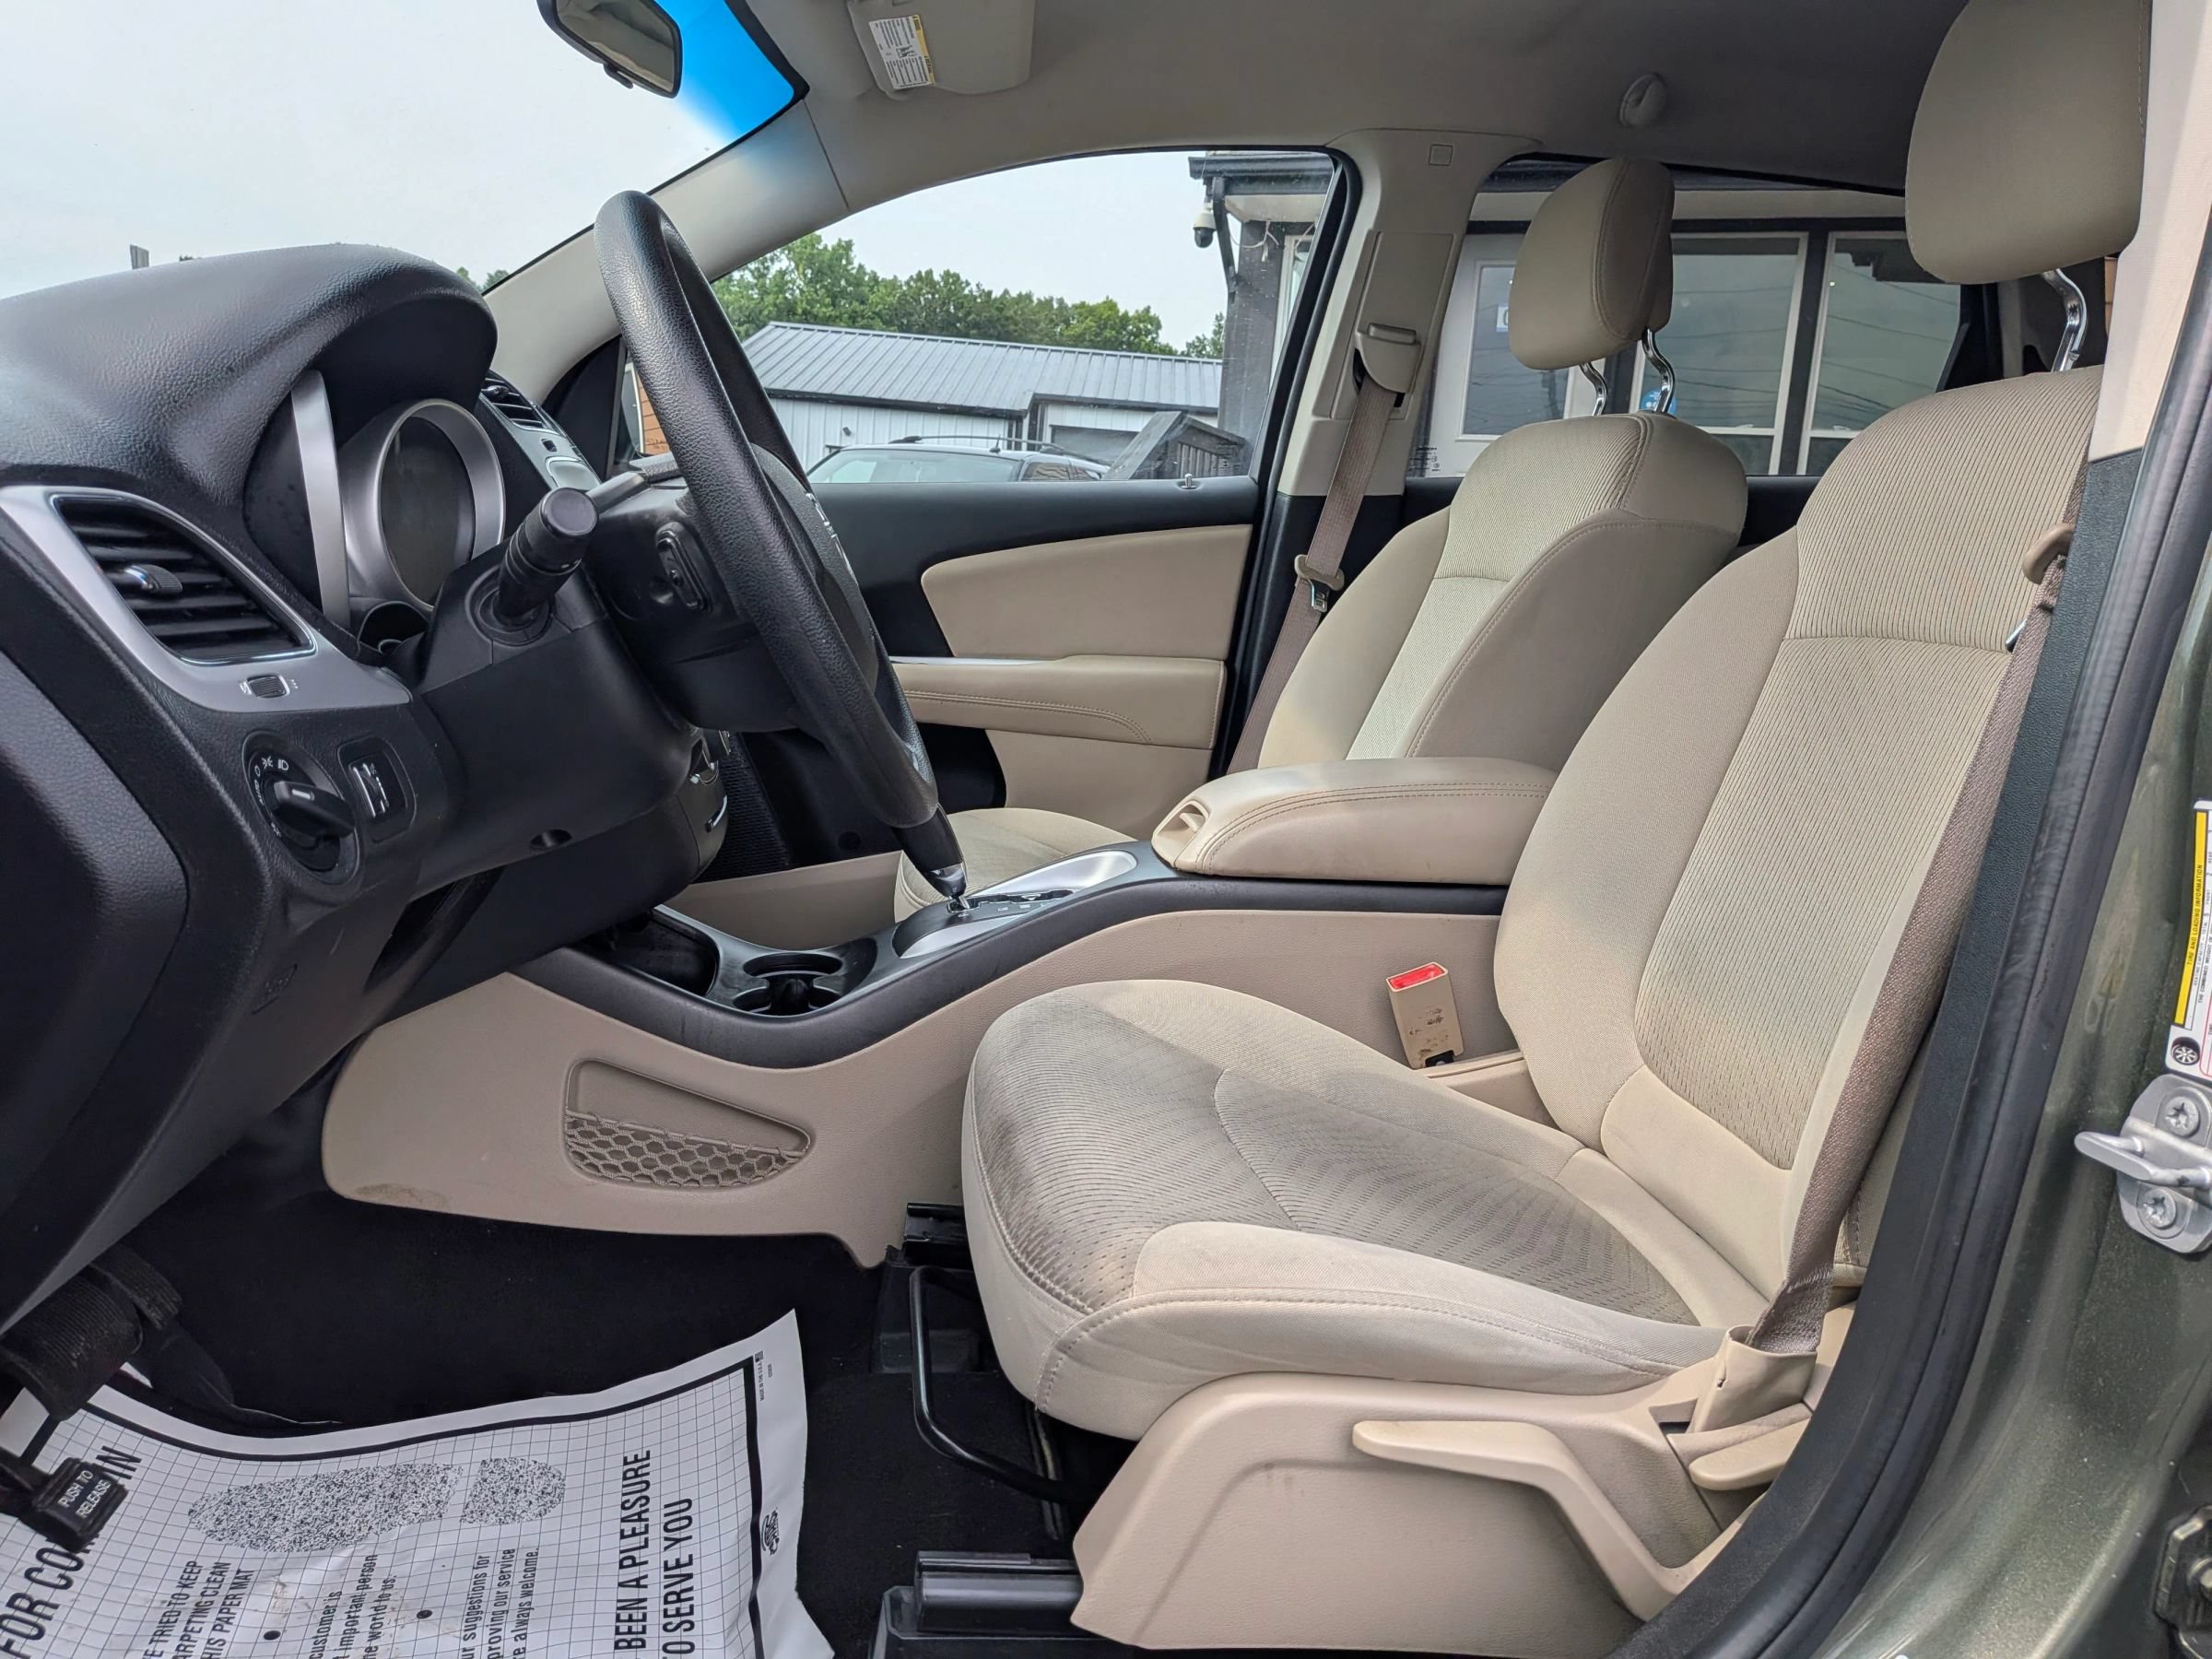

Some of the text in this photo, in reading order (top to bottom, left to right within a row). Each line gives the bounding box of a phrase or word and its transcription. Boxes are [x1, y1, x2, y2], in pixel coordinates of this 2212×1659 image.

[2195, 864, 2204, 908] INFORMATION
[2193, 908, 2201, 935] LOADING
[2186, 952, 2194, 965] TIRE
[57, 1470, 94, 1509] PUSH TO
[75, 1479, 112, 1519] RELEASE
[176, 1560, 204, 1589] KEEP
[472, 1555, 490, 1571] for
[518, 1547, 539, 1598] welcome.
[614, 1450, 651, 1651] BEEN A PLEASURE
[167, 1593, 190, 1606] TO
[333, 1593, 368, 1652] important
[356, 1554, 379, 1592] person
[486, 1548, 516, 1659] proving our service
[662, 1498, 695, 1659] O SERVE YOU
[0, 1593, 61, 1659] FOR
[148, 1610, 182, 1645] TRIED
[171, 1561, 232, 1659] ARPETING CLEAN
[200, 1568, 255, 1659] HIS PAPER MAT
[309, 1591, 343, 1659] customer is
[363, 1574, 398, 1659] he world to us.
[462, 1572, 488, 1641] suggestions
[511, 1601, 535, 1642] always
